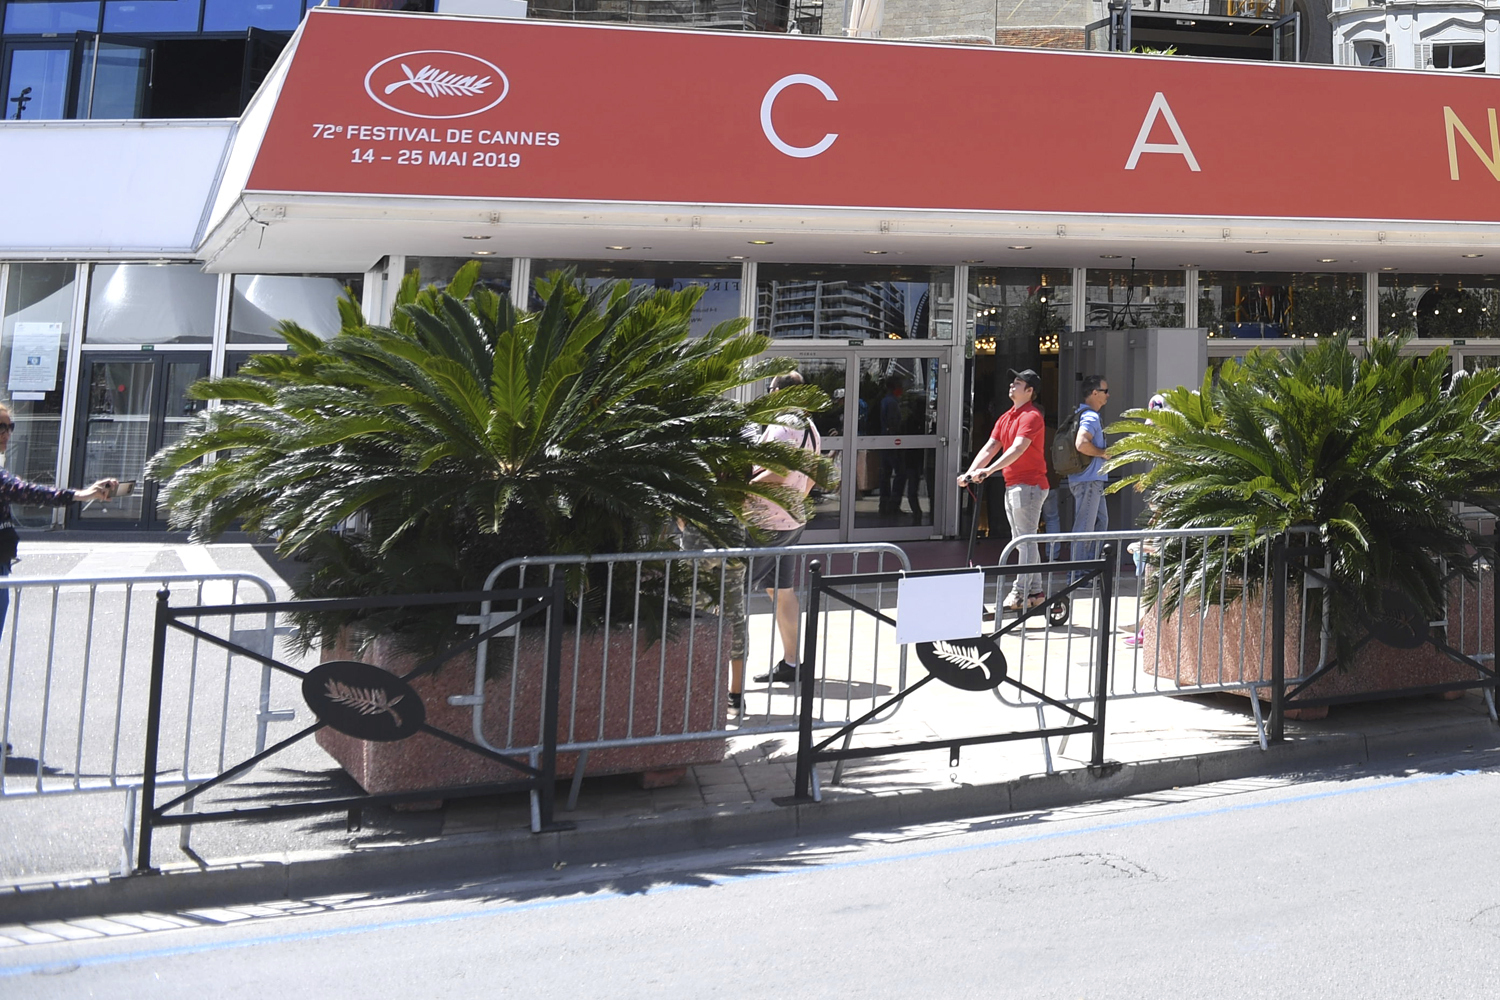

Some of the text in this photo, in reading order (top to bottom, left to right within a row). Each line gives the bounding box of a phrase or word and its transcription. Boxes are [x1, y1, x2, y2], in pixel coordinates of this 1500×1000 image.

[346, 125, 441, 142] FESTIVAL
[446, 129, 473, 143] DE
[478, 130, 560, 146] CANNES
[351, 148, 375, 163] 14
[397, 149, 423, 165] 25
[428, 151, 467, 166] MAI
[472, 152, 521, 168] 2019
